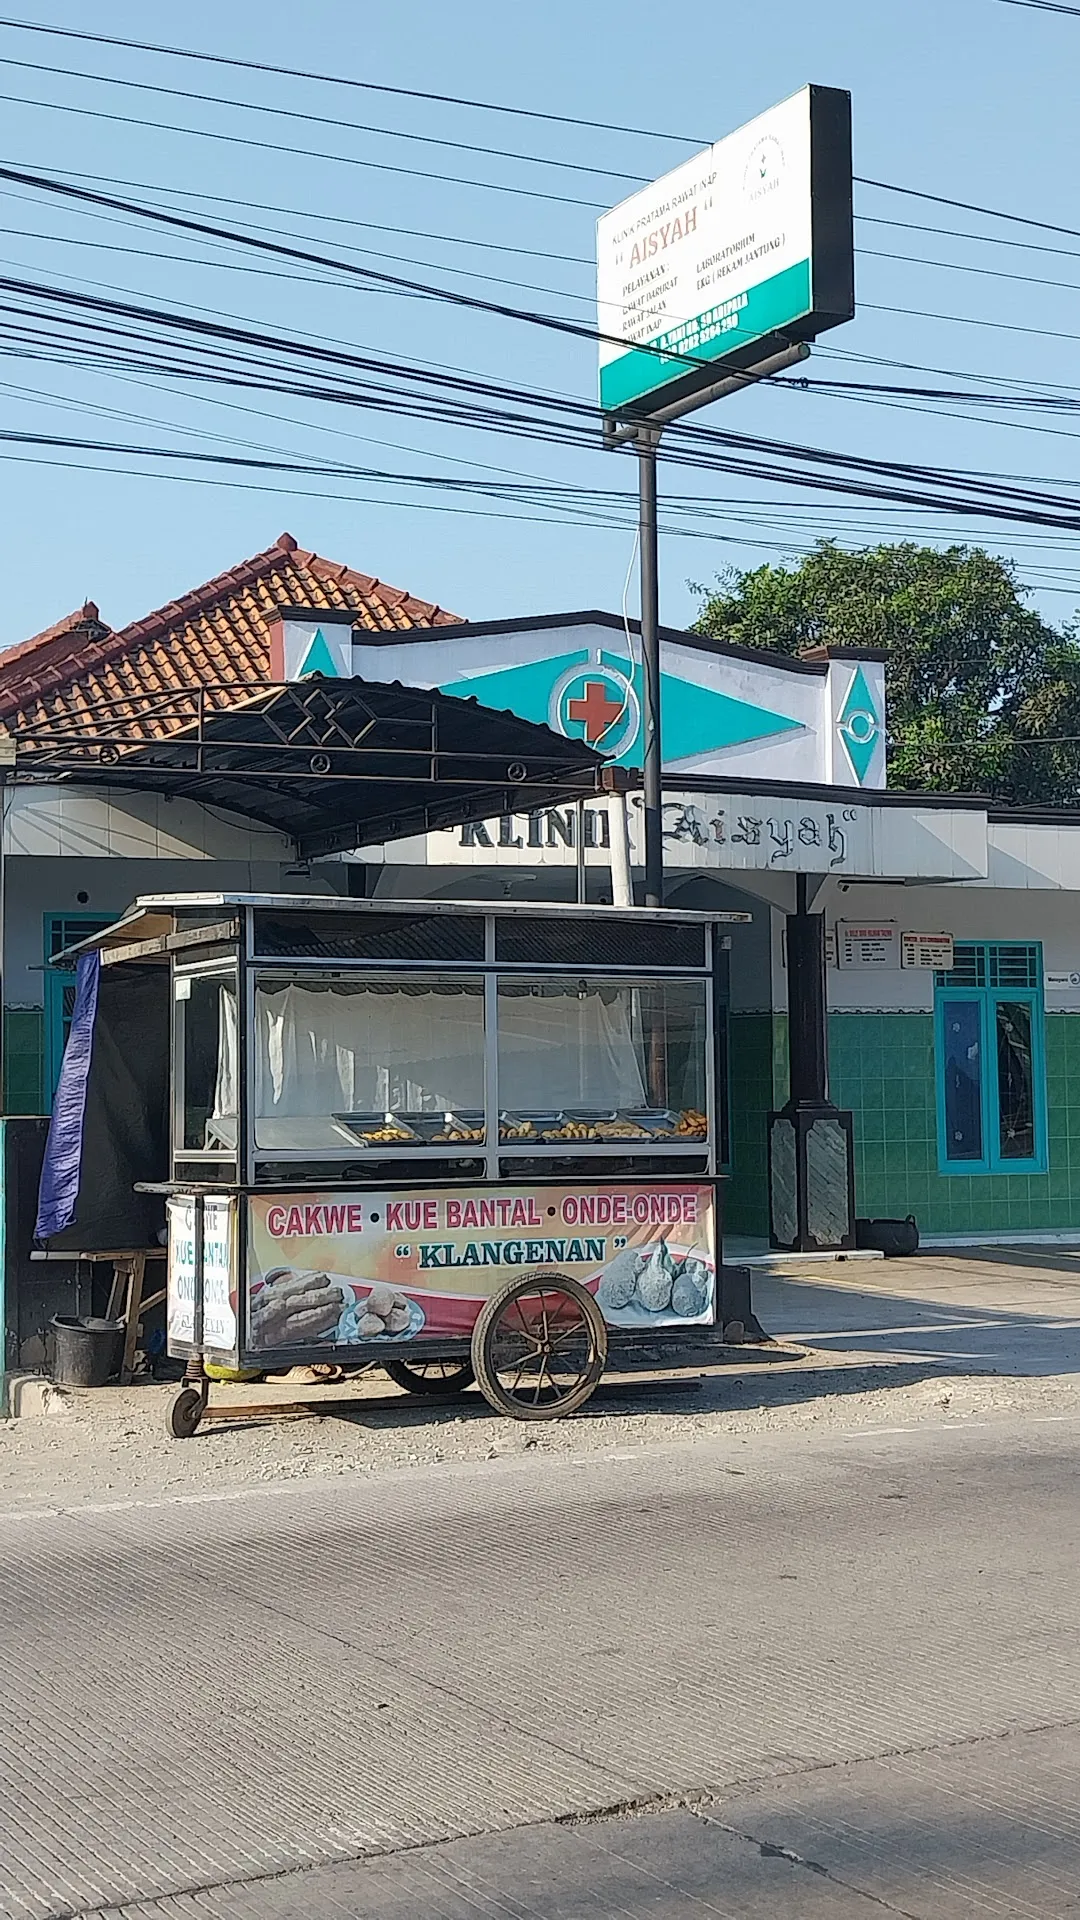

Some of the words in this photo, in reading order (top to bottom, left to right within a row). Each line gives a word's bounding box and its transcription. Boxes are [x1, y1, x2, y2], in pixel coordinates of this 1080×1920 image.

[636, 202, 671, 231] PRATAMA
[629, 206, 697, 269] AISYAH
[267, 1204, 362, 1237] CAKWE
[385, 1201, 437, 1232] KUE
[445, 1198, 542, 1230] BANTAL
[562, 1195, 697, 1226] ONDE-ONDE
[418, 1238, 606, 1269] KLANGENAN
